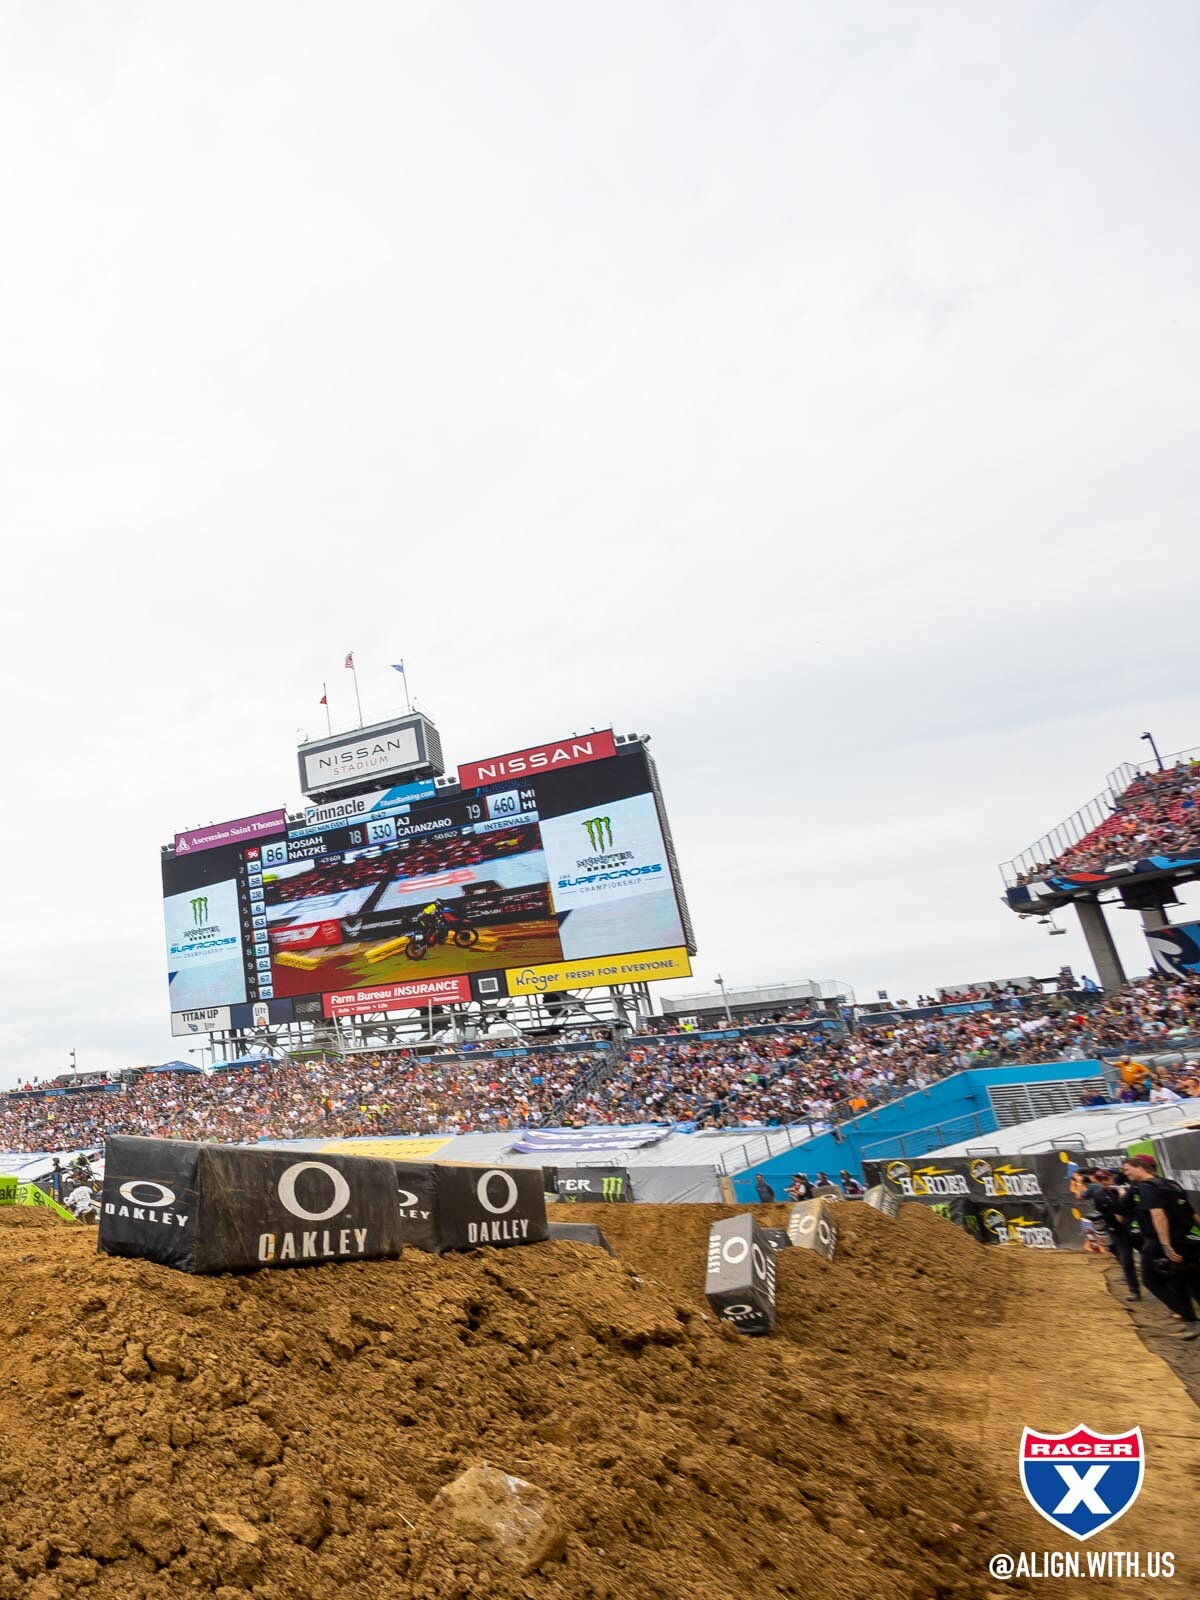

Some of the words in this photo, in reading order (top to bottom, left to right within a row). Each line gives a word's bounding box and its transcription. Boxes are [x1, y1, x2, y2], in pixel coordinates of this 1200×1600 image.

[319, 738, 401, 769] NISSAN
[477, 741, 593, 780] NISSAN
[333, 755, 389, 776] STADIUM
[306, 800, 365, 825] Pinnacle
[466, 804, 481, 820] 19
[493, 796, 515, 813] 460
[330, 820, 346, 829] EVENT
[397, 817, 410, 826] AJ
[397, 818, 452, 836] CATANZARO
[483, 815, 530, 831] INTERVALS
[191, 831, 230, 846] Ascension
[230, 825, 251, 837] Saint
[252, 818, 284, 831] Thomas
[349, 830, 362, 844] 18
[371, 824, 392, 840] 330
[288, 836, 323, 850] JOSIAH
[248, 851, 259, 859] 96
[266, 847, 283, 862] 86
[289, 845, 327, 860] NATZKE
[576, 851, 636, 868] MONSTER
[250, 877, 261, 885] 58
[557, 864, 662, 889] SUPERCROSS
[580, 878, 642, 894] CHAMPIONSHIP
[255, 918, 264, 926] 63
[170, 937, 237, 954] SUPERCROSS
[257, 946, 267, 954] 57
[259, 960, 269, 968] 62
[516, 969, 560, 991] Kroger
[565, 970, 594, 980] FRESH
[597, 967, 618, 976] FOR
[621, 960, 674, 974] EVERYONE
[262, 988, 272, 996] 66
[331, 995, 355, 1005] Farm
[357, 991, 392, 1001] Bureau
[394, 980, 459, 996] INSURANCE
[182, 1010, 208, 1022] TITAN
[208, 1009, 219, 1019] UP
[204, 1022, 215, 1030] Lite
[105, 1202, 190, 1228] OAKLEY
[468, 1219, 529, 1243] OAKLEY
[257, 1227, 368, 1261] OAKLEY
[708, 1234, 721, 1274] OAKLEY
